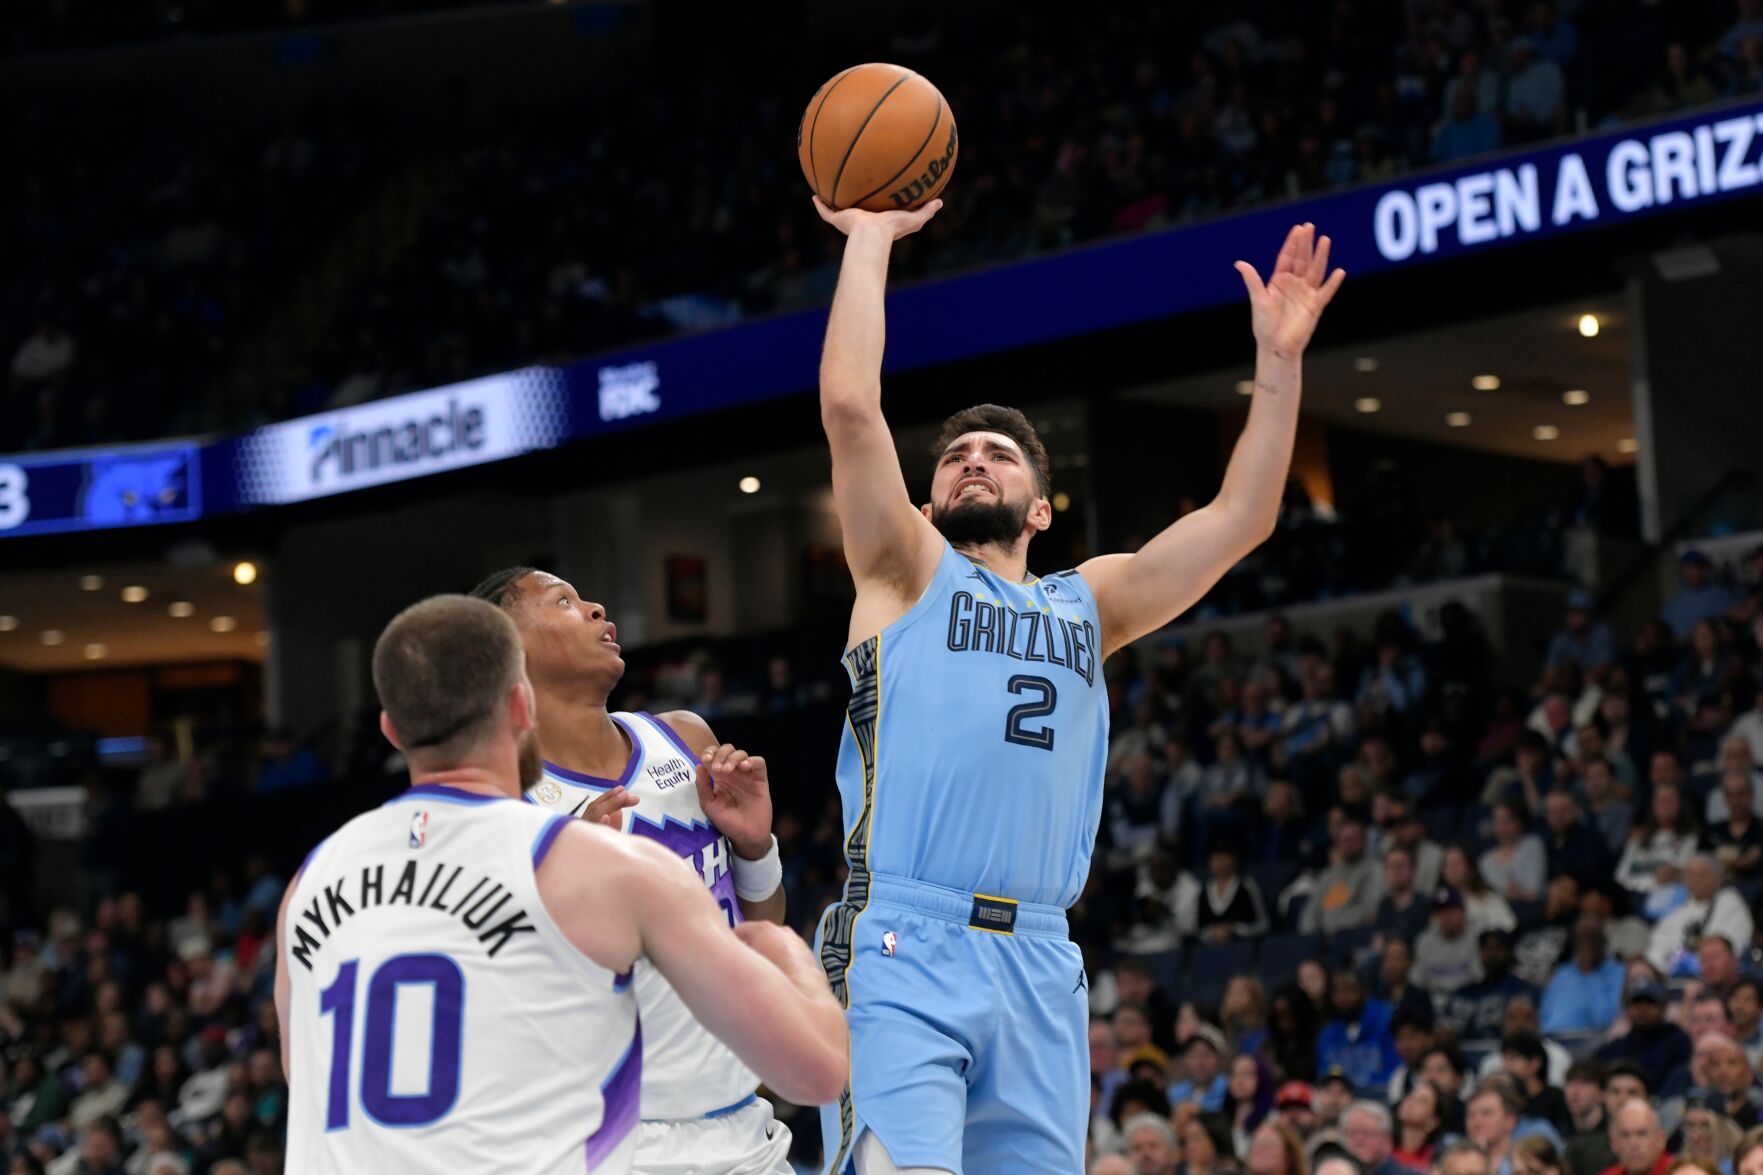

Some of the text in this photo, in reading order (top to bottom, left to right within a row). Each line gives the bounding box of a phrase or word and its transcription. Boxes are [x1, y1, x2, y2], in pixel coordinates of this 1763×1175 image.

[1374, 163, 1541, 261] OPEN
[1552, 153, 1599, 226] A
[308, 398, 485, 481] Pinnacle
[947, 591, 1095, 688] GRIZZLIES
[1004, 674, 1057, 752] 2
[647, 758, 685, 778] Health
[655, 770, 690, 790] Equity
[292, 860, 536, 971] MYKHAILIUK
[320, 952, 466, 1133] 10
